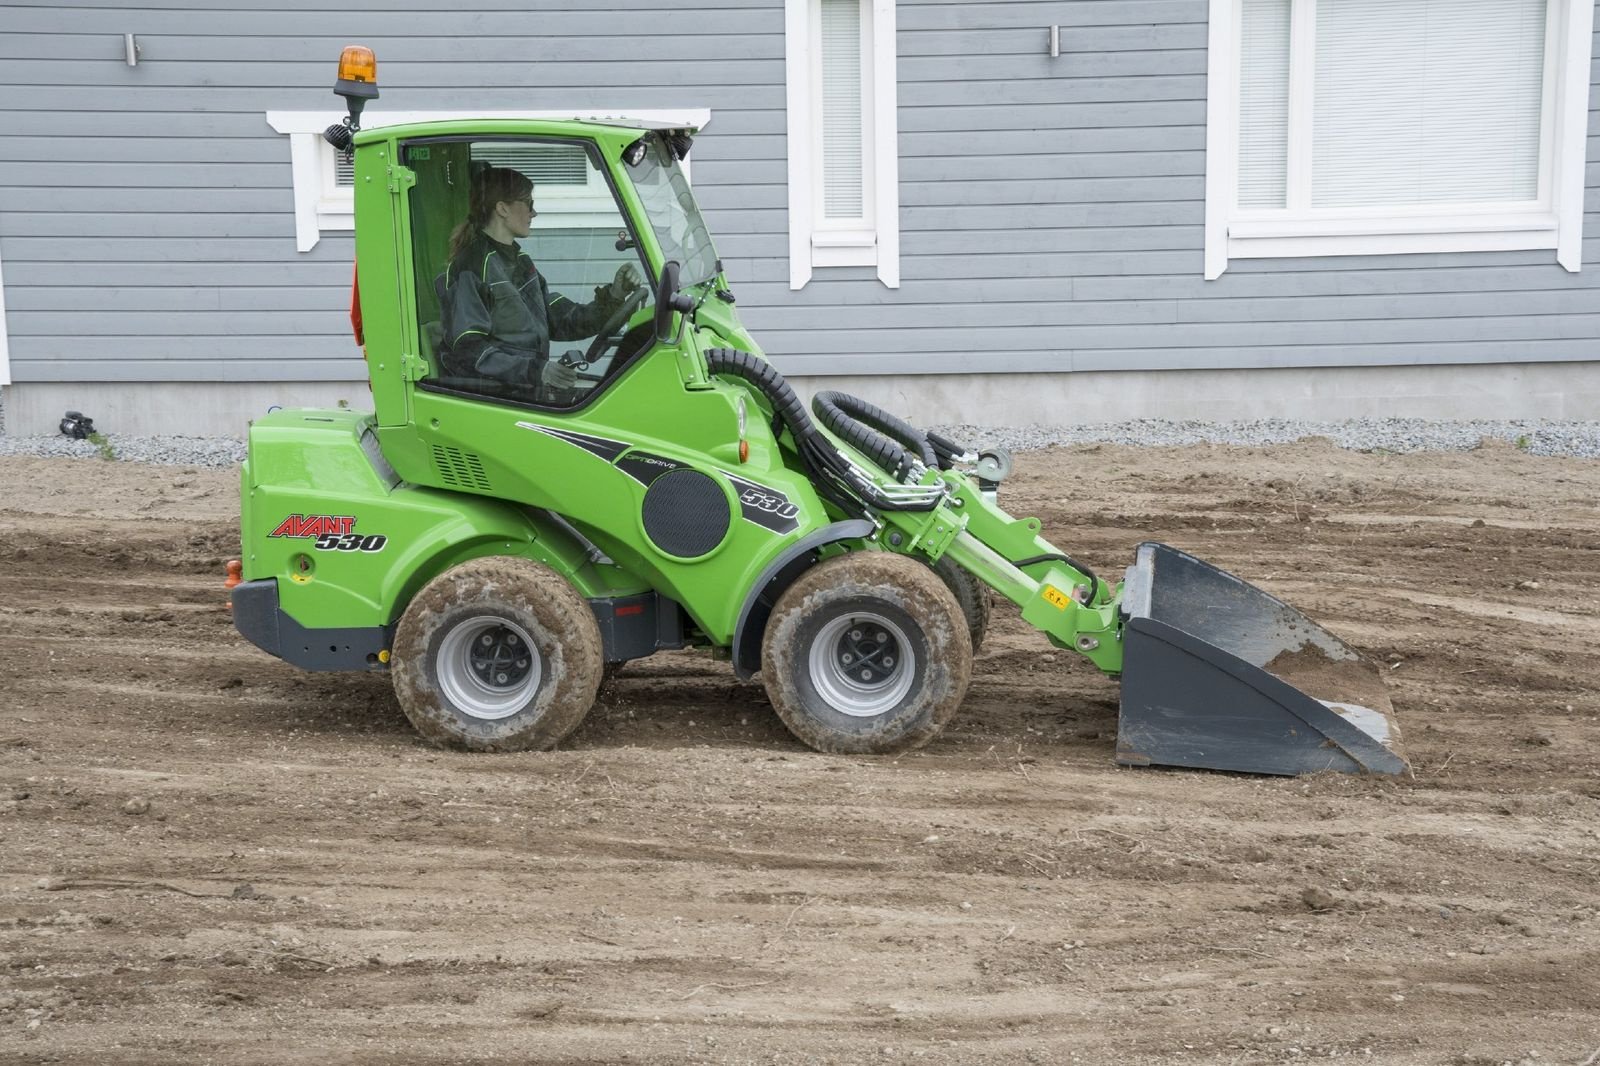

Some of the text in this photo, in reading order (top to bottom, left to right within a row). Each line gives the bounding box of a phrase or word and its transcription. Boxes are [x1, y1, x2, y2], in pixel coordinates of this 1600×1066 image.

[740, 489, 800, 518] 530
[267, 513, 357, 538] AVANT
[315, 534, 388, 553] 530
